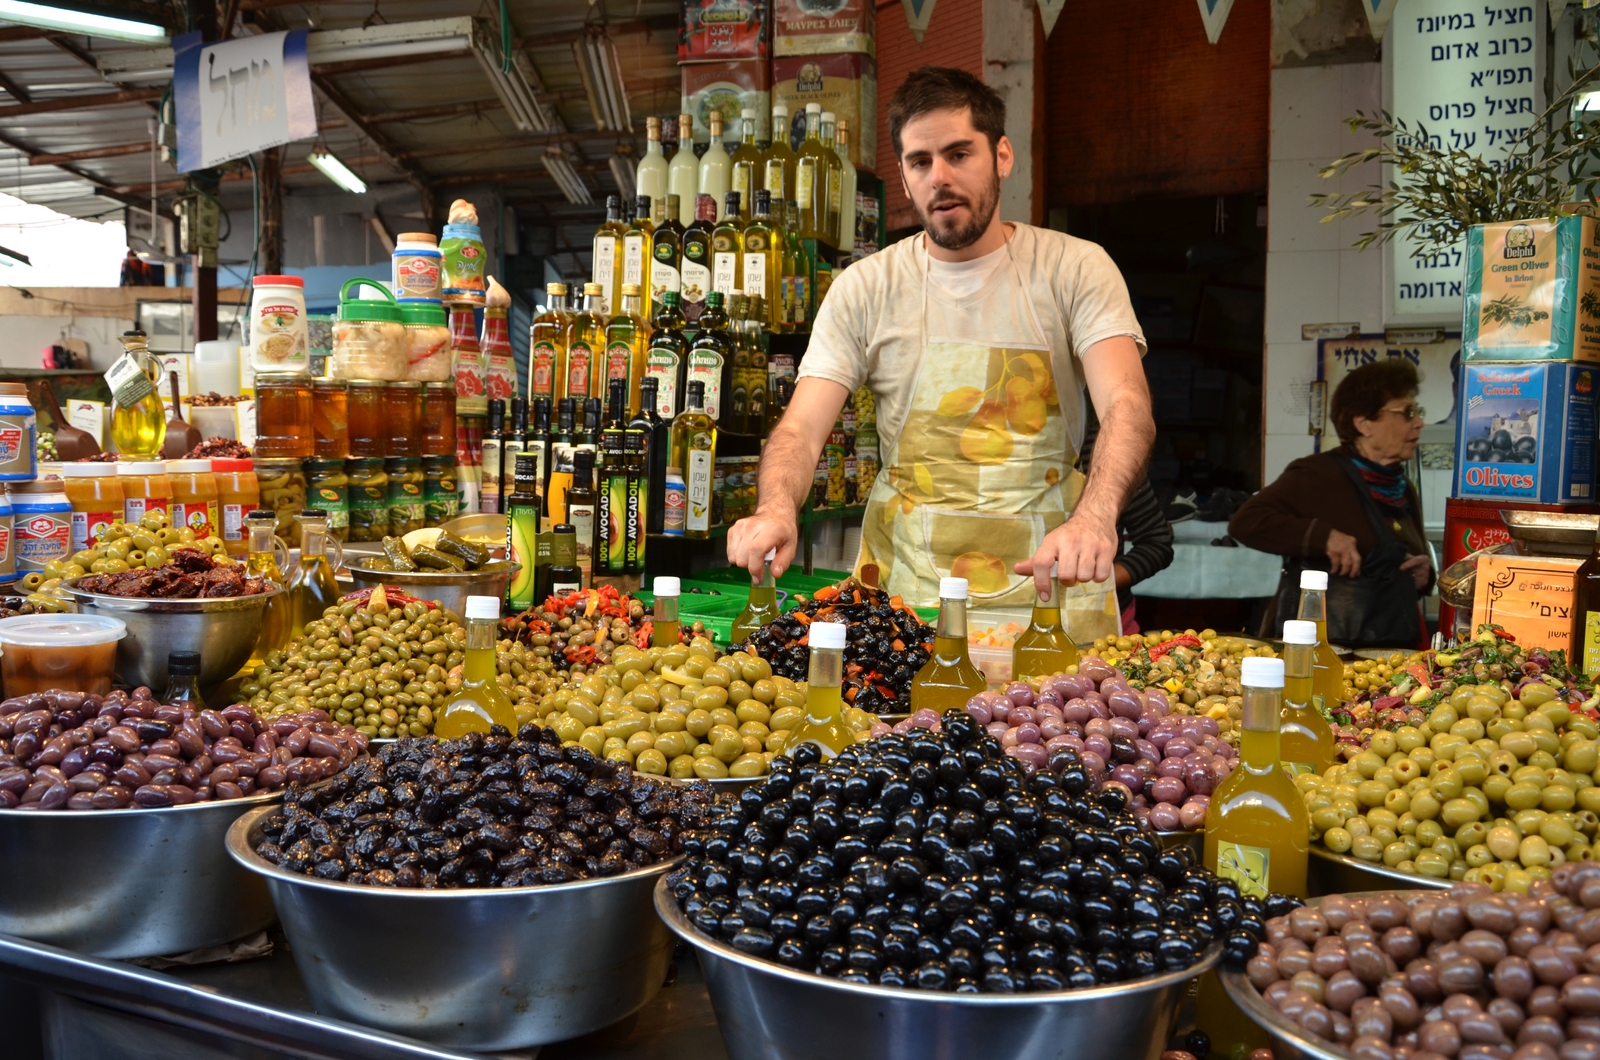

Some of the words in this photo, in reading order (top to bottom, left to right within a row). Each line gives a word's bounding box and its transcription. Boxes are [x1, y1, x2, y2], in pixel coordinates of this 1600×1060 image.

[1416, 13, 1475, 33] במיונז
[1484, 6, 1532, 27] חציל
[1431, 42, 1479, 61] אדום
[1488, 36, 1532, 56] כרוב
[1430, 102, 1475, 121] פרוס
[1485, 96, 1532, 117] חציל
[1451, 129, 1476, 150] על
[1486, 126, 1532, 146] חציל
[1416, 247, 1462, 269] לבנה
[1506, 246, 1533, 258] Delphi
[1491, 263, 1518, 273] Green
[1521, 260, 1549, 270] Olives
[717, 272, 731, 282] שמן
[748, 273, 761, 283] שמן
[1400, 281, 1461, 299] אדומה
[1477, 371, 1530, 383] Selected
[1483, 384, 1521, 396] Greek
[693, 472, 707, 483] שמן
[1466, 466, 1534, 488] Olives
[693, 486, 706, 496] זית
[600, 540, 608, 562] 100%
[628, 540, 636, 561] 100%
